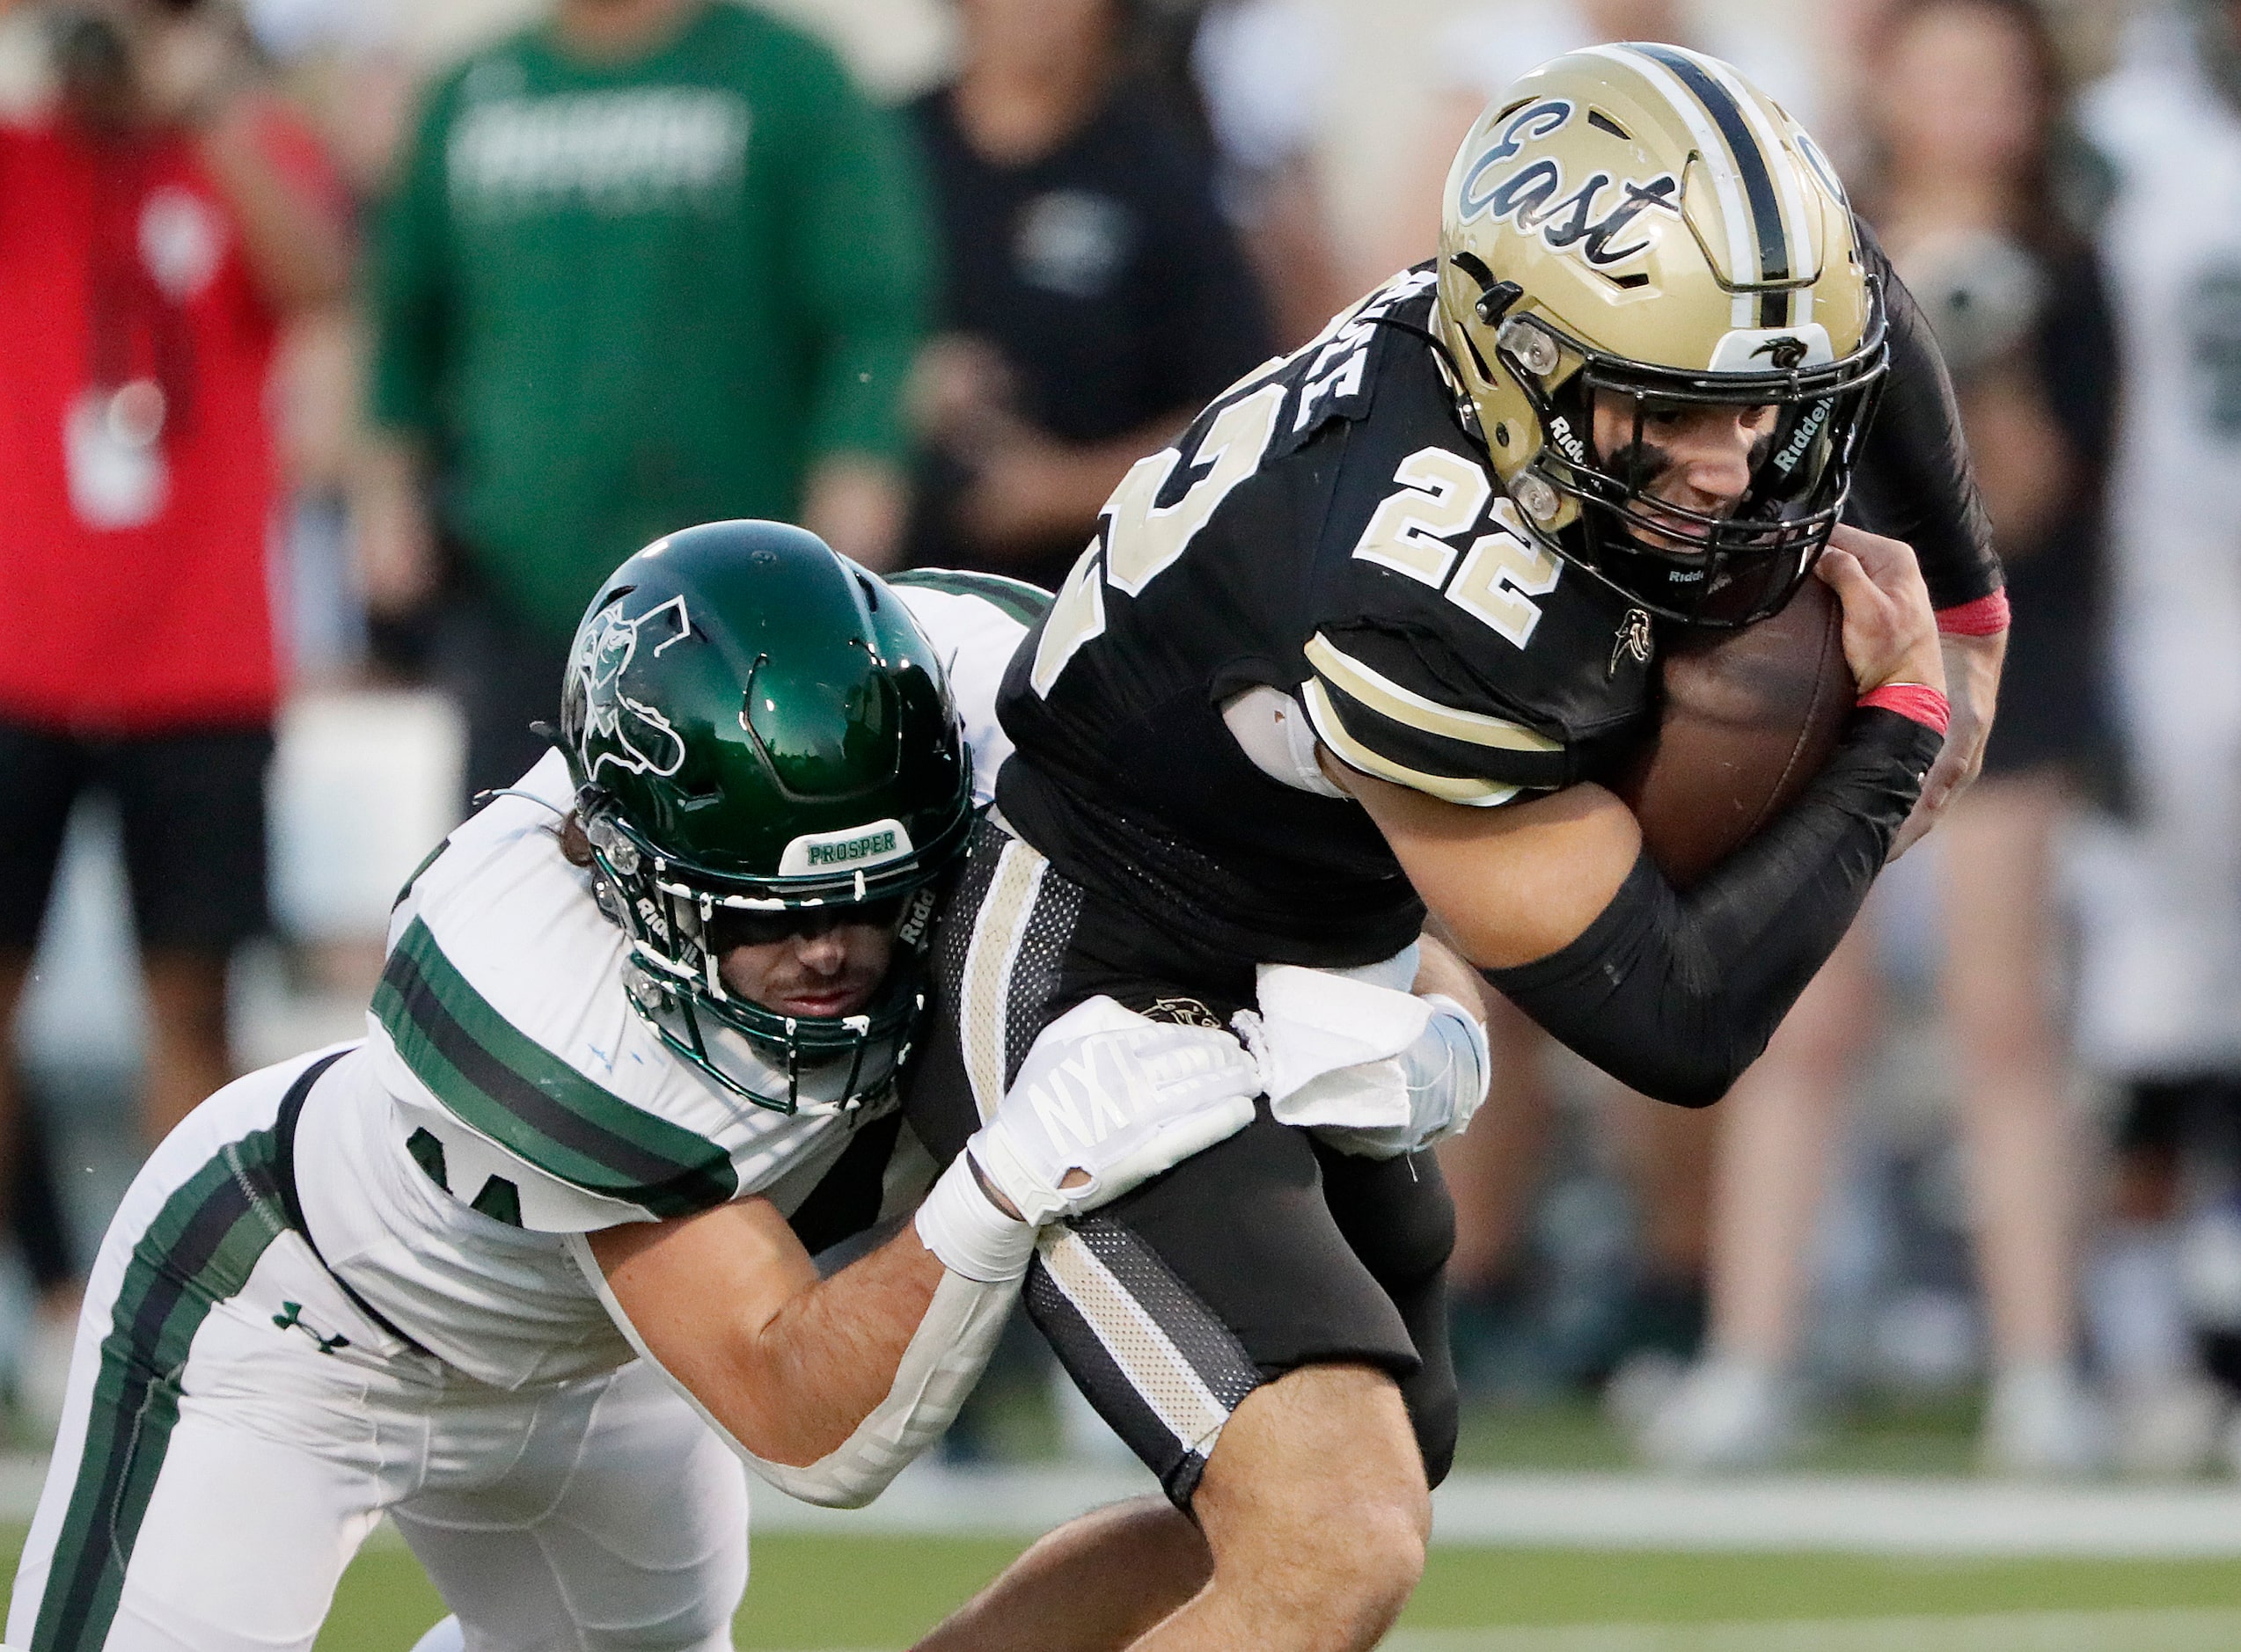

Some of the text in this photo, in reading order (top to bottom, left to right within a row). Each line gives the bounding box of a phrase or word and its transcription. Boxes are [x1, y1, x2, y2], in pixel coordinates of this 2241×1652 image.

[1458, 100, 1681, 267] East
[1351, 446, 1564, 651] 22
[808, 830, 897, 866] PROSPER
